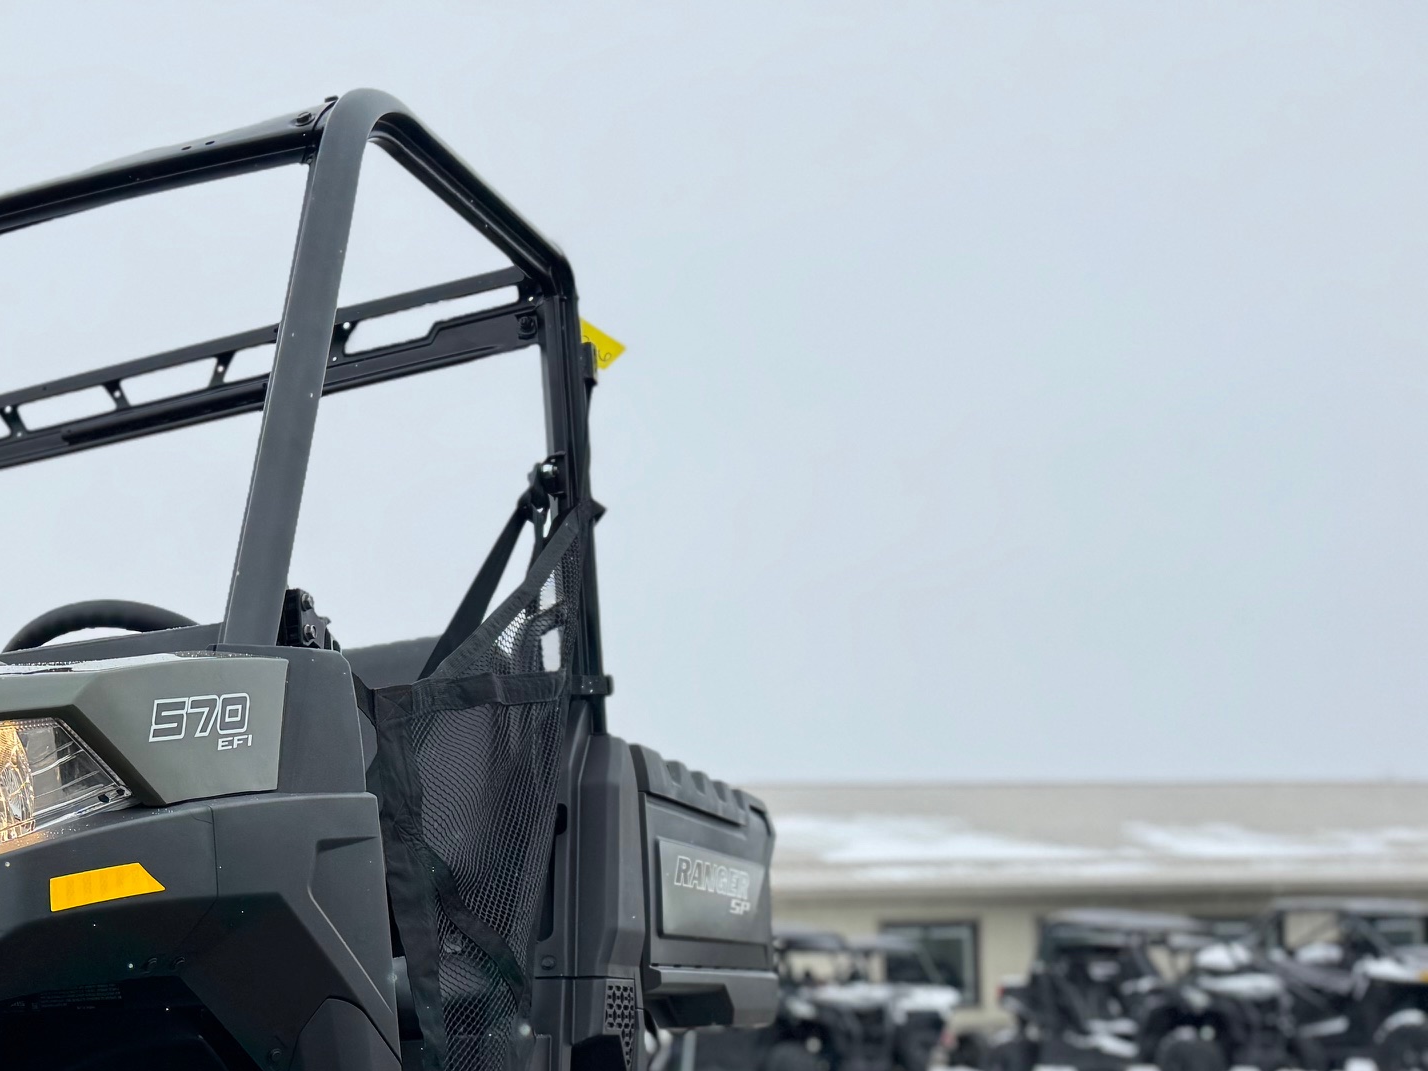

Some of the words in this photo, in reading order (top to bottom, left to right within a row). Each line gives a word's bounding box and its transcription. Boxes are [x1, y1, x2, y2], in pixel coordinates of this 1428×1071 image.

[149, 692, 250, 742] 570
[217, 734, 253, 750] EFI
[674, 855, 750, 900] RANGER
[729, 898, 751, 915] SP
